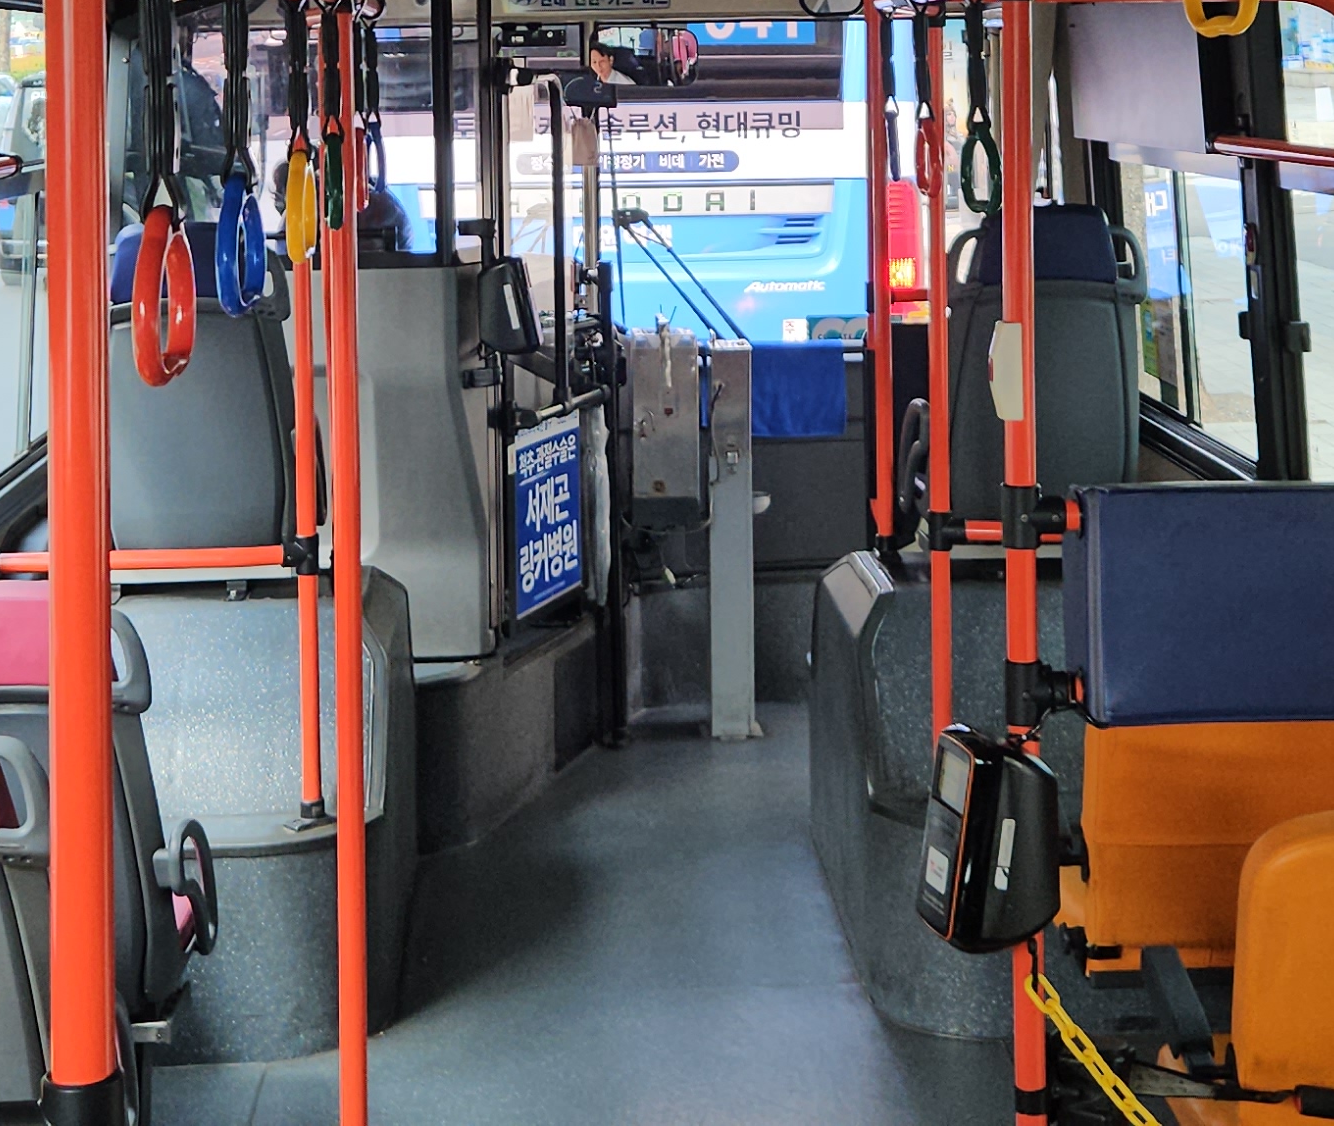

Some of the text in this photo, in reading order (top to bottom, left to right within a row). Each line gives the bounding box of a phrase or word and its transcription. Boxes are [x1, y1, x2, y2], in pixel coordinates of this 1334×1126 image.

[696, 111, 801, 138] 현대큐밍
[658, 153, 685, 169] 비데
[698, 153, 725, 169] 가전
[744, 279, 826, 294] Automatic
[525, 473, 571, 532] 서재곤
[520, 520, 578, 593] 링커병원
